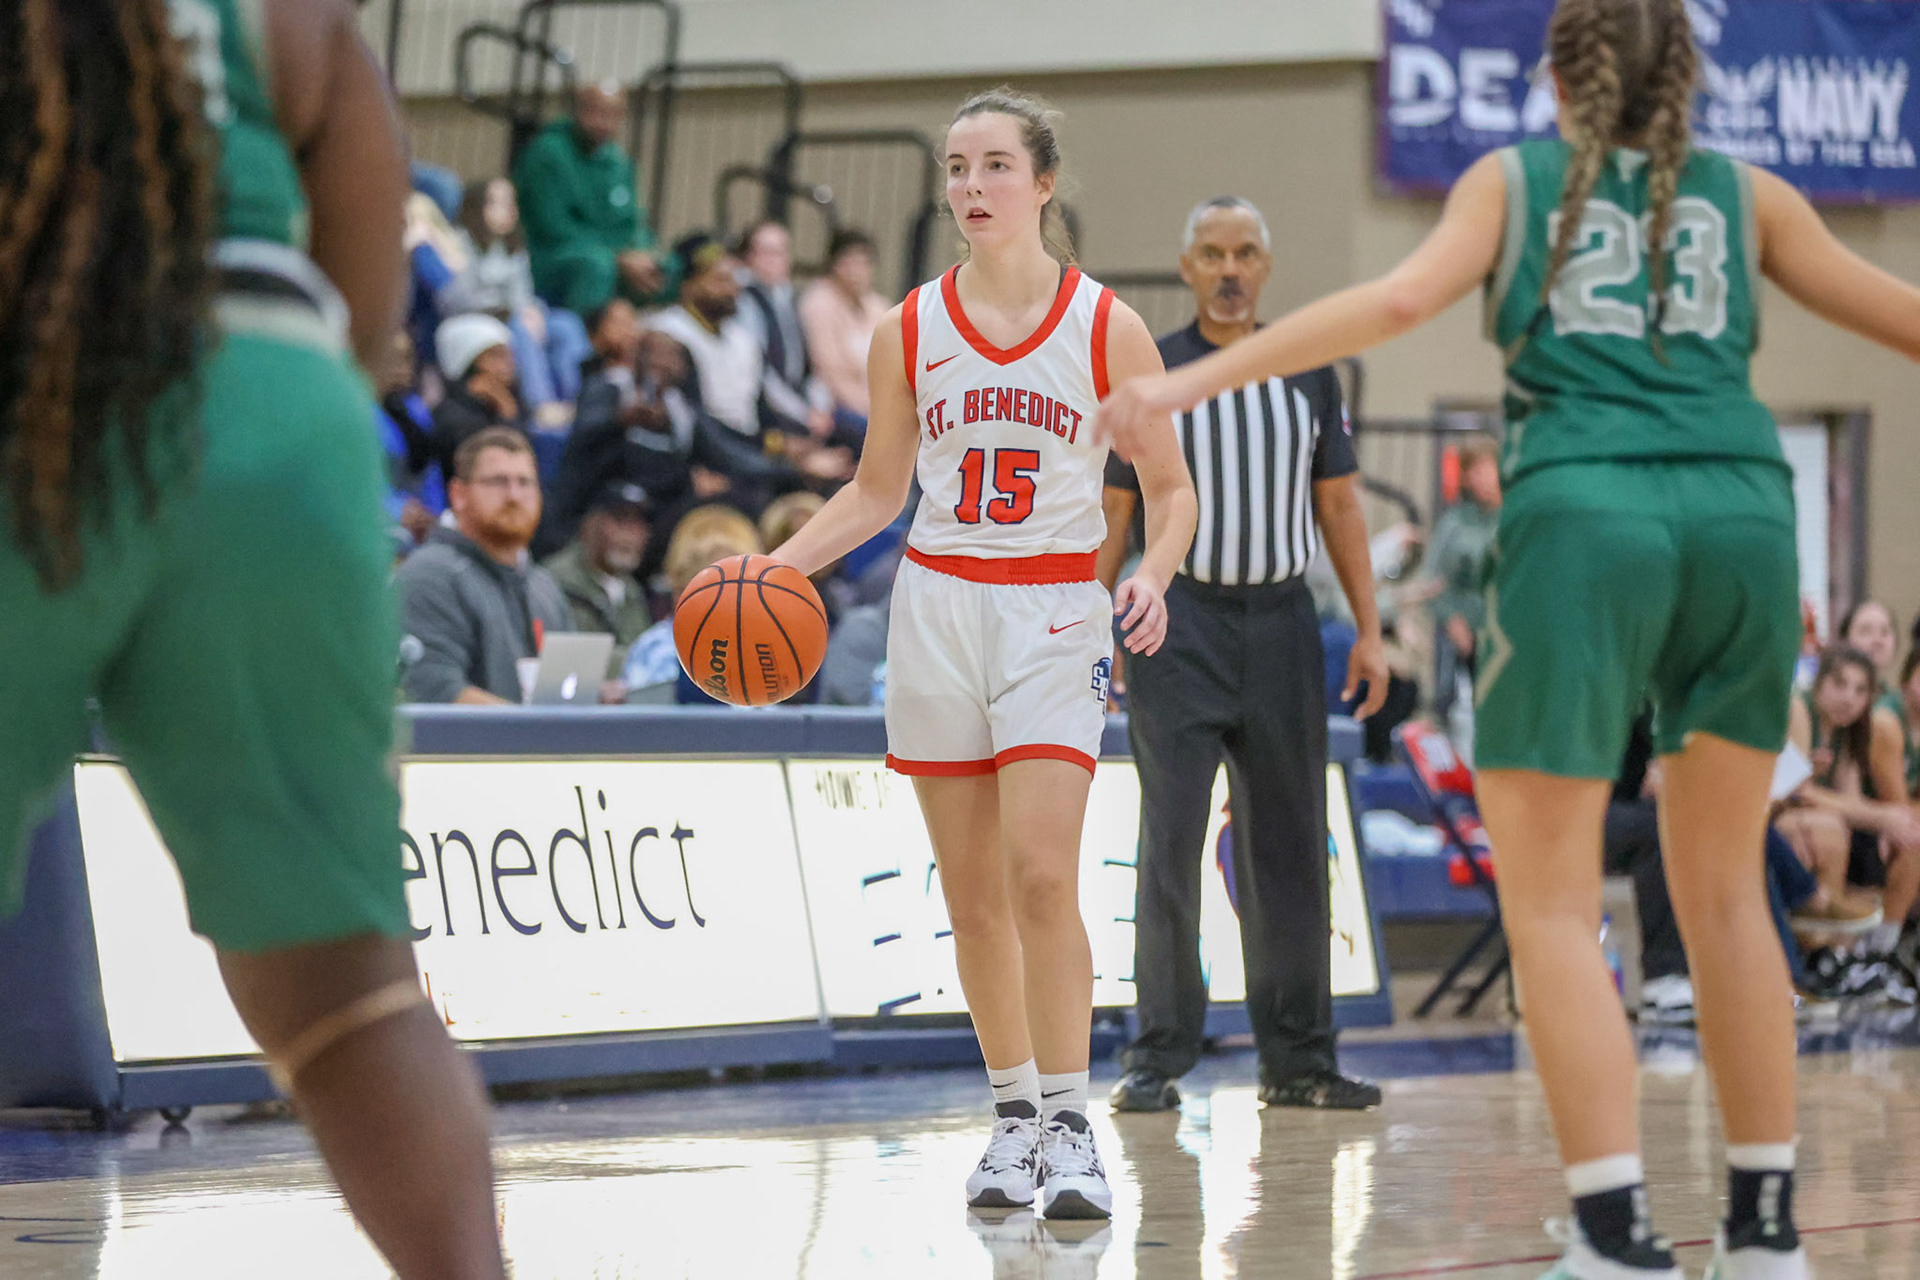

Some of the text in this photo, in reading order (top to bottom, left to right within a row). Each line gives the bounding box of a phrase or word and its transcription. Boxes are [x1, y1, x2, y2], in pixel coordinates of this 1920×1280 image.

[1777, 55, 1910, 142] NAVY
[1548, 198, 1728, 340] 23
[926, 386, 1083, 444] ST. BENEDICT
[954, 447, 1041, 525] 15
